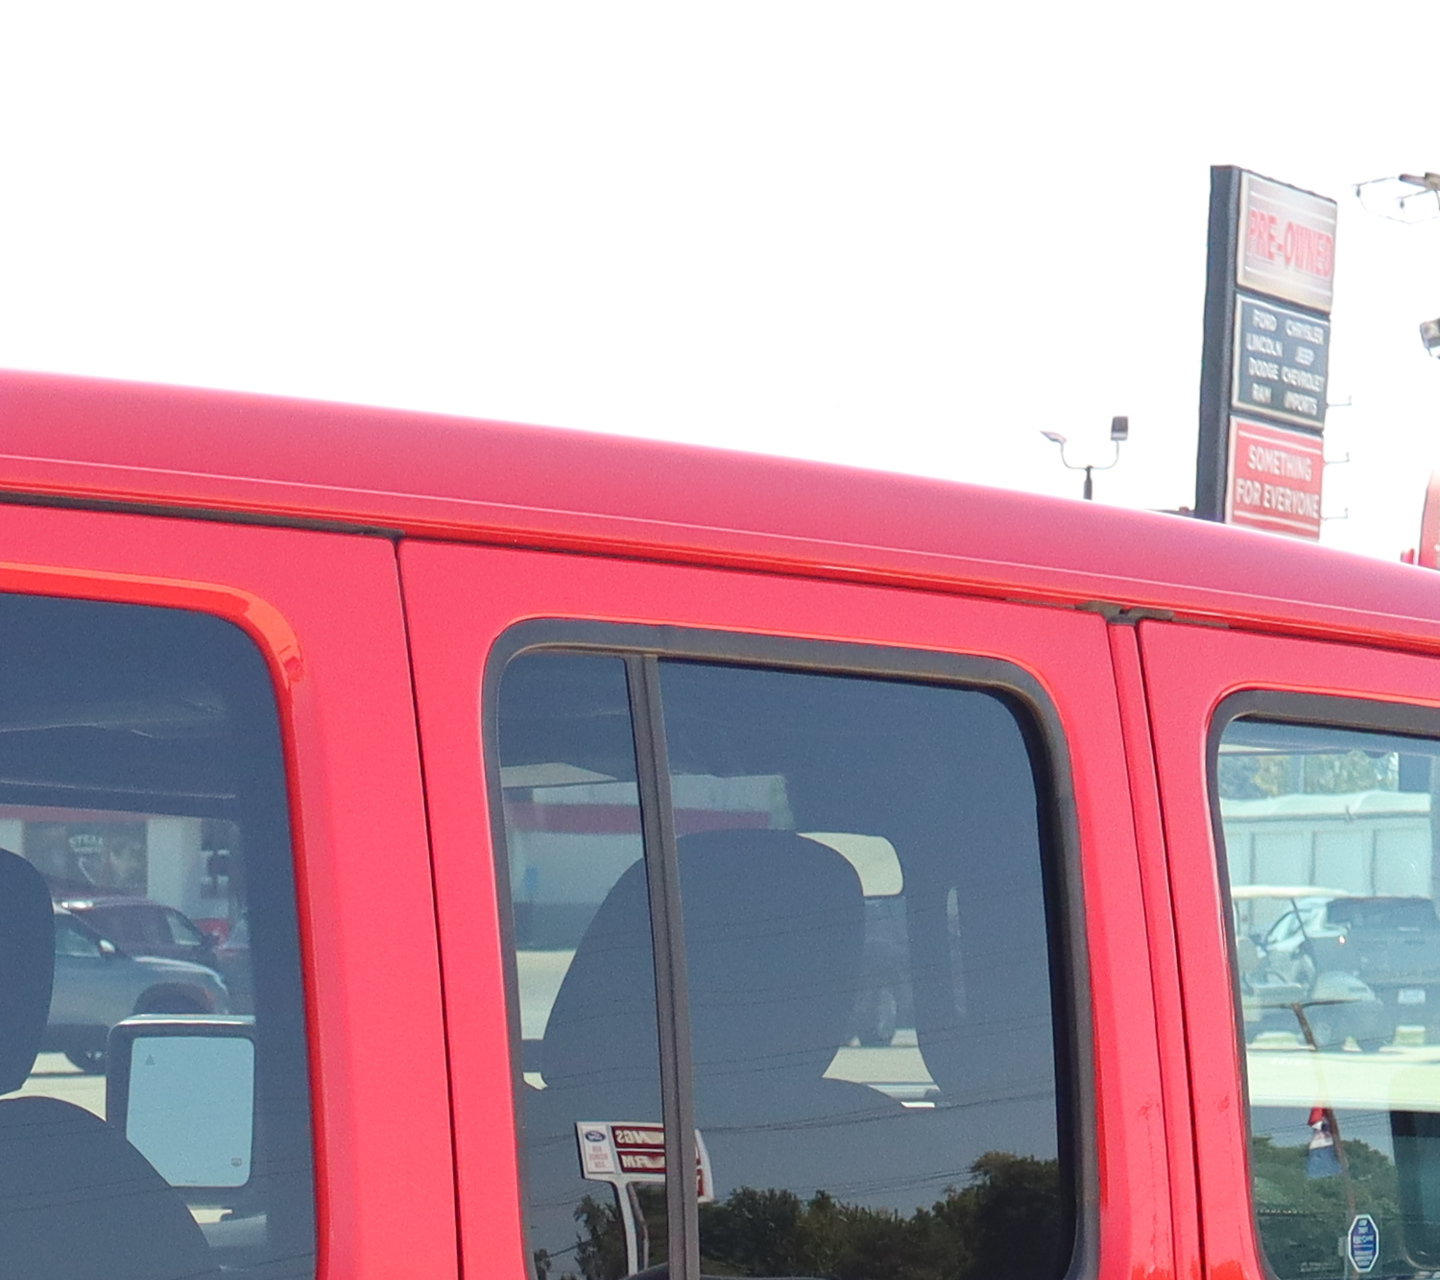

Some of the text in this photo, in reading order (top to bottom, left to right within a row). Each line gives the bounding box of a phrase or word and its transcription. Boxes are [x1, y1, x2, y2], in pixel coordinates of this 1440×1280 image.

[1247, 209, 1333, 277] PRE-OWNED
[1246, 332, 1282, 357] LINCOLN
[1253, 309, 1324, 345] FORD CHRYSLER
[1248, 357, 1324, 392] DODGE CHEVROLET
[1284, 391, 1317, 416] IMPORTS
[1247, 444, 1312, 482] SOMETHING
[1235, 478, 1320, 519] FOR EVERYONE
